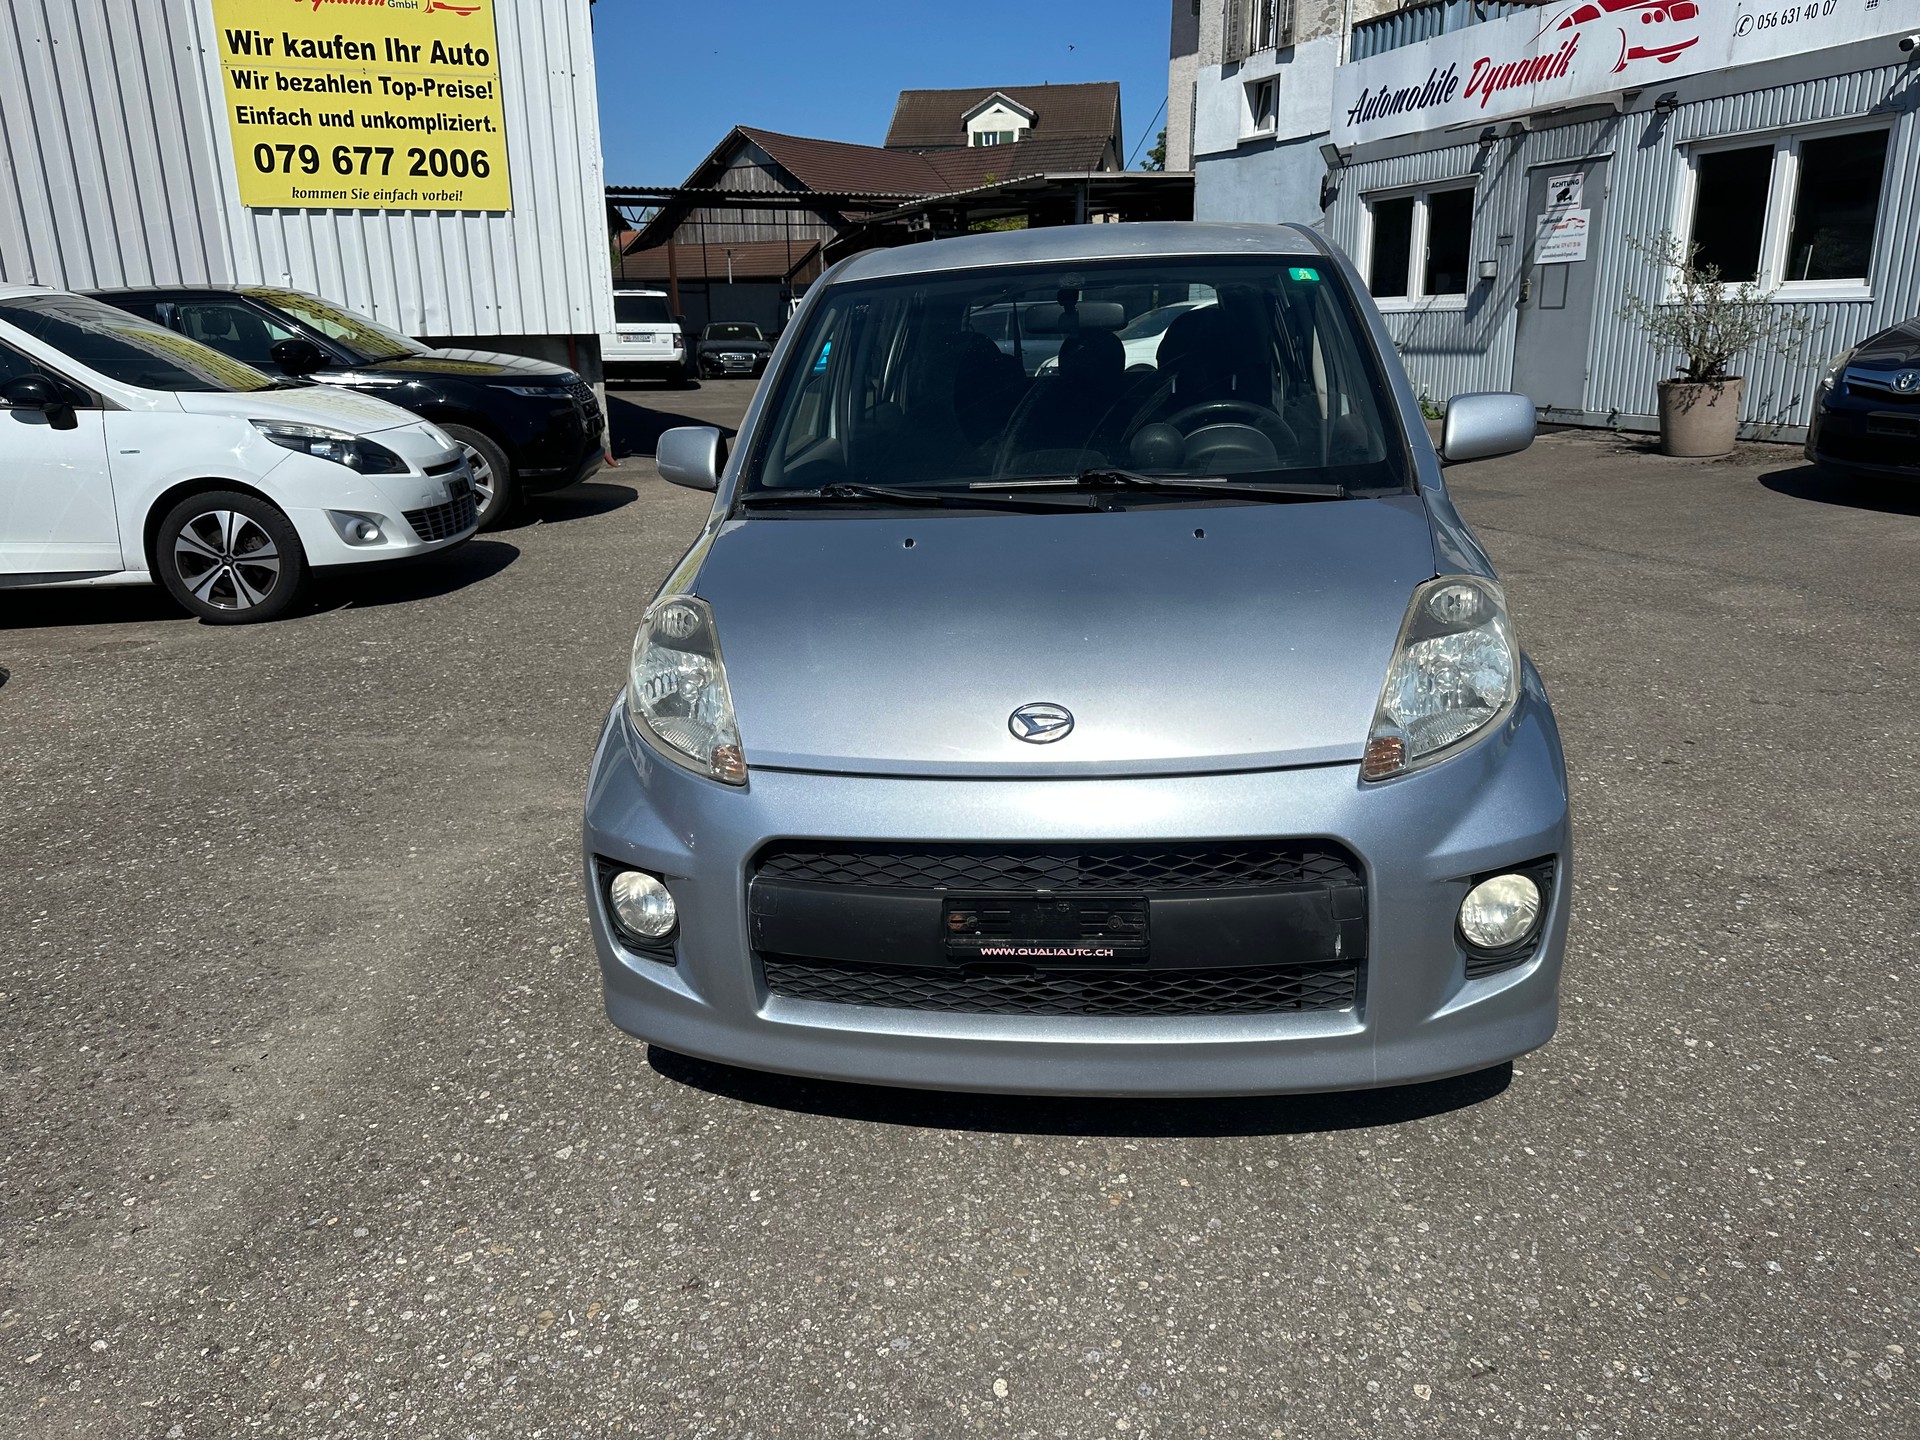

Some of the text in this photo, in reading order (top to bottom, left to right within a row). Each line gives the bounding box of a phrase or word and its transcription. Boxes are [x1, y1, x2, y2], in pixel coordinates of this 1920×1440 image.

[387, 0, 418, 9] GmbH
[1757, 0, 1838, 30] 056 631 40 07
[225, 29, 490, 67] Wir kaufen Ihr Auto
[231, 69, 494, 101] Wir bezahlen Top-Preise!
[1347, 32, 1581, 127] Automobile Dynamik
[235, 105, 497, 134] Einfach und unkompliziert.
[253, 143, 491, 178] 079 677 2006
[291, 187, 463, 203] kommen Sie einfach vorbei!
[1551, 179, 1579, 188] ACHTUNG
